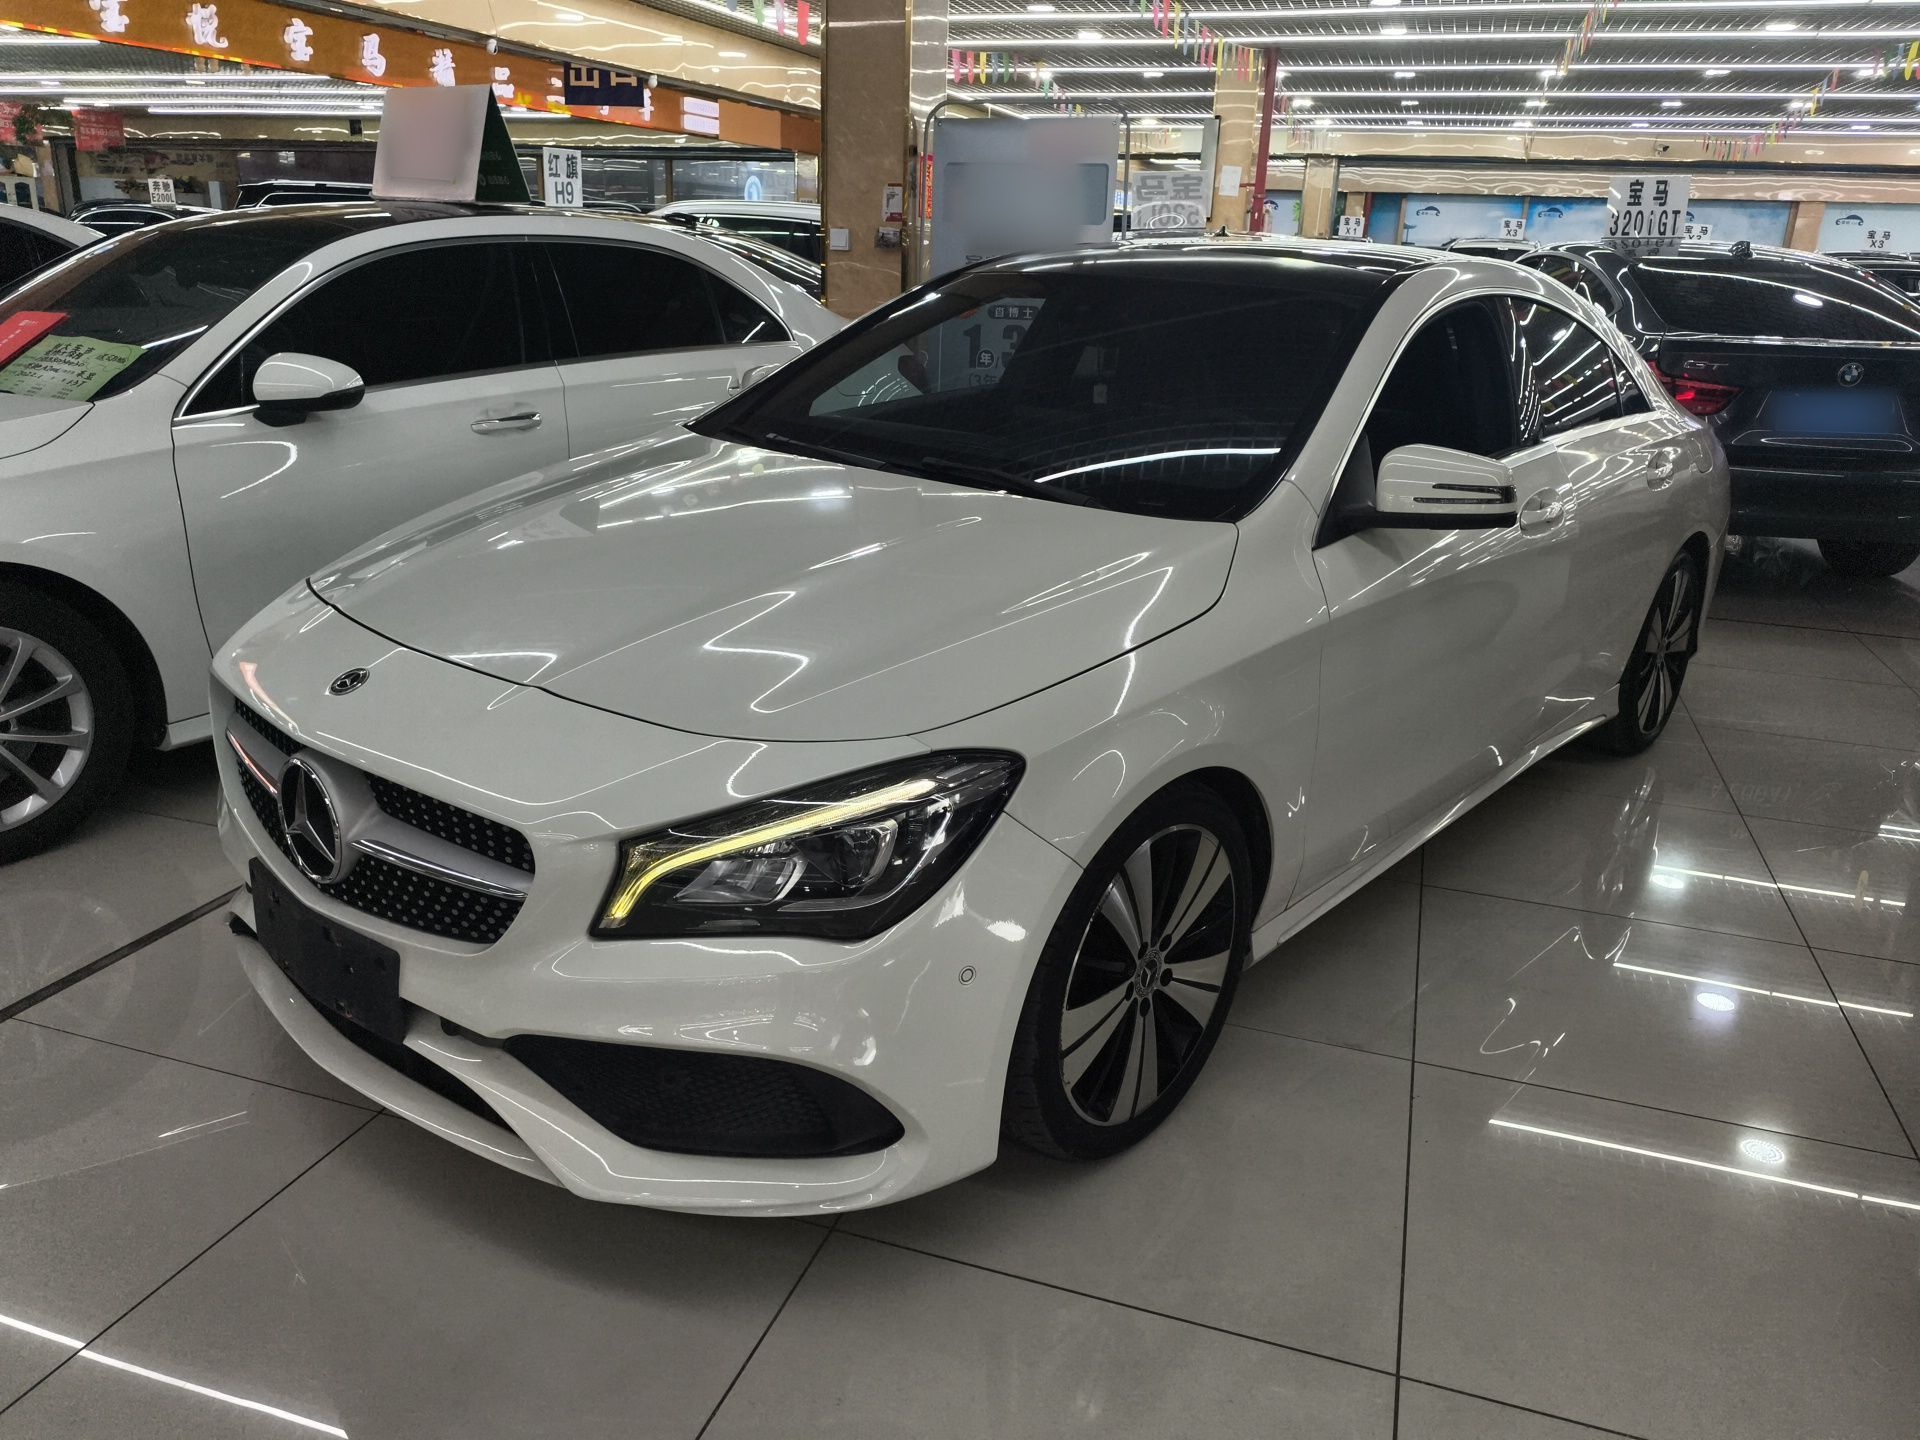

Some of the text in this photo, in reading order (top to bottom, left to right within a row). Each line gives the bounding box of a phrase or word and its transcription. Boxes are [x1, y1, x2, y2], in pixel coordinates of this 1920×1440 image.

[547, 153, 579, 179] 红旗
[152, 181, 172, 192] 奔驰
[151, 193, 175, 203] E200L
[554, 181, 574, 205] H9
[1627, 179, 1669, 207] 宝马
[1343, 217, 1361, 227] 宝马
[1503, 220, 1523, 230] 宝马
[1610, 210, 1681, 237] 320iGT
[1505, 229, 1518, 237] X3
[1684, 225, 1709, 236] 宝马
[1867, 230, 1891, 240] 宝马
[1869, 240, 1885, 248] X3
